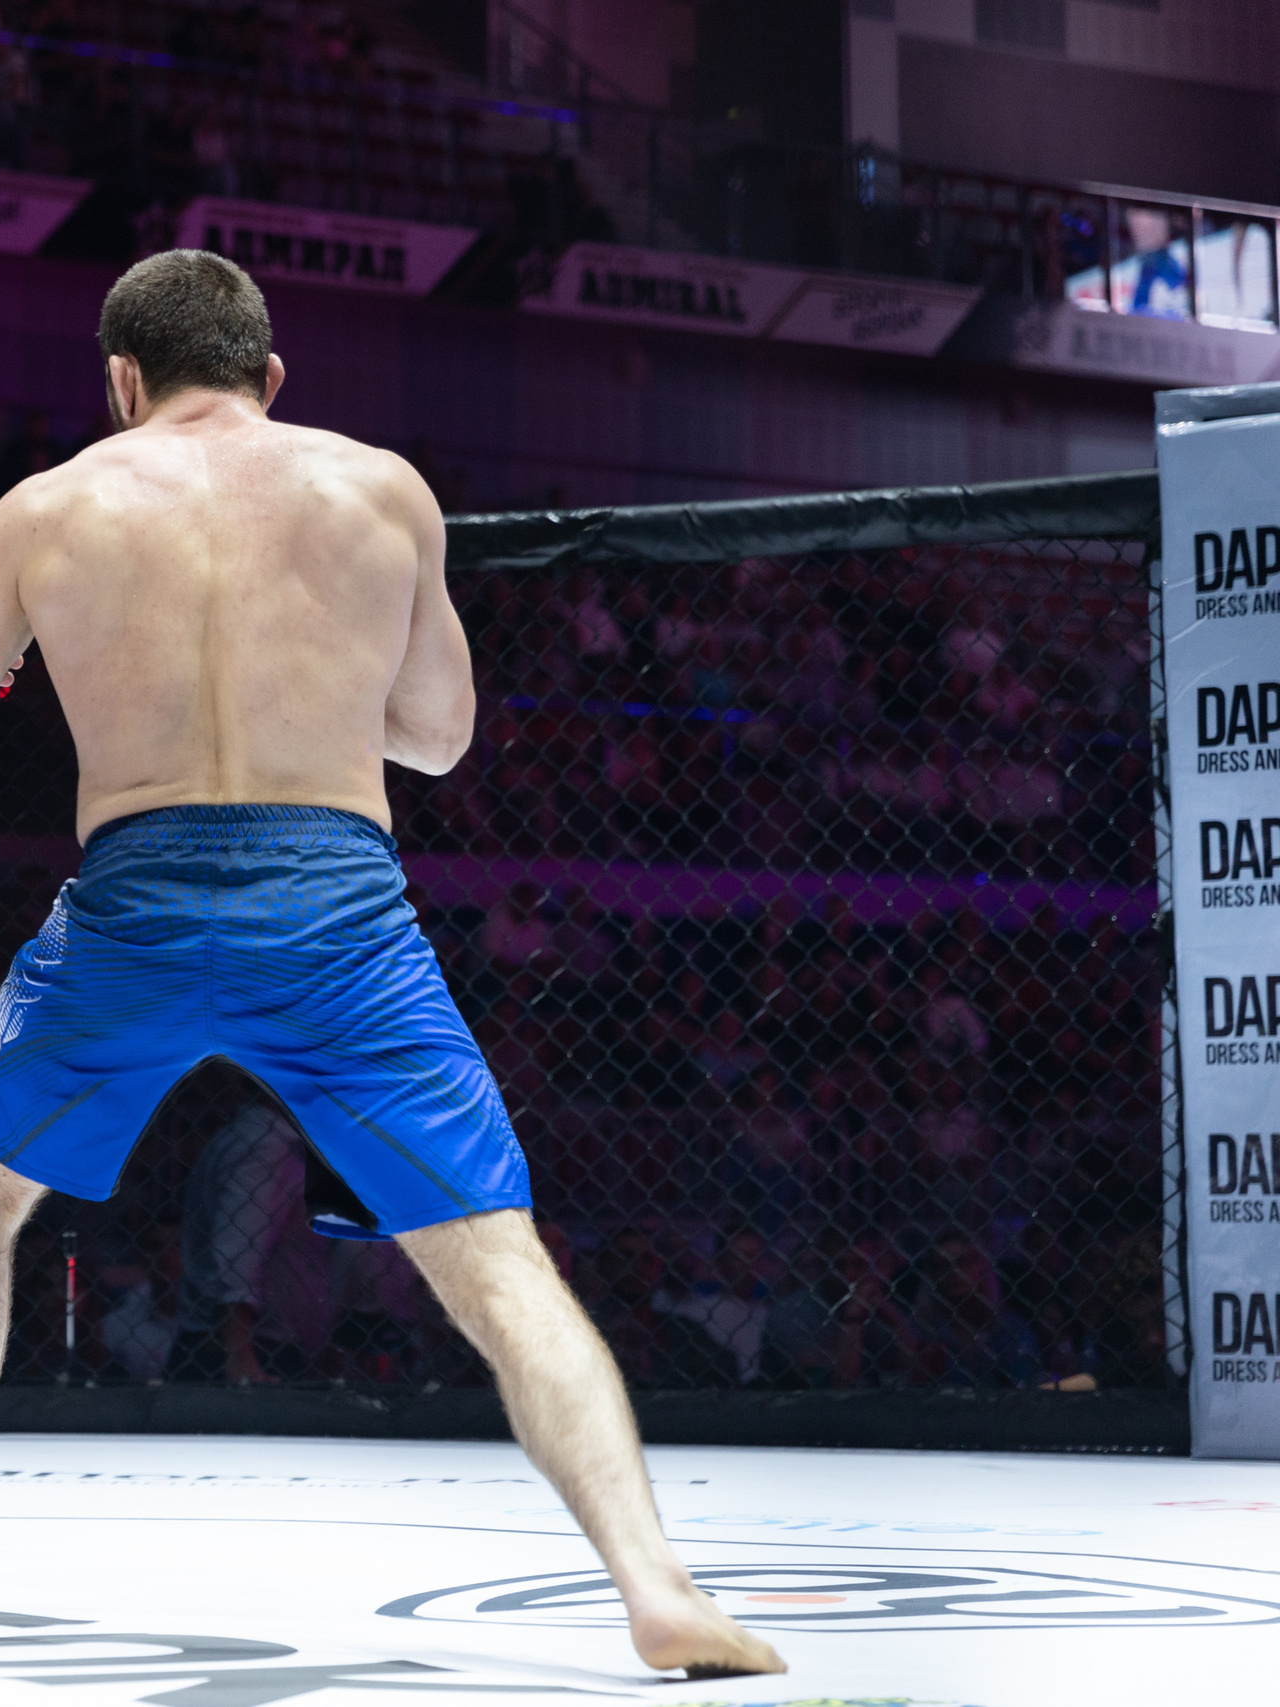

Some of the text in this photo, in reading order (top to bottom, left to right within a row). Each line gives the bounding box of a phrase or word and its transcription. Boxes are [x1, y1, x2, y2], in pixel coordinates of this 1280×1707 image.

[1196, 595, 1248, 620] DRESS
[1197, 748, 1280, 774] DRESS AN
[1202, 885, 1254, 909] DRESS
[1206, 1042, 1259, 1065] DRESS
[1210, 1201, 1264, 1222] DRESS
[1213, 1293, 1280, 1354] DA
[1213, 1359, 1267, 1382] DRESS
